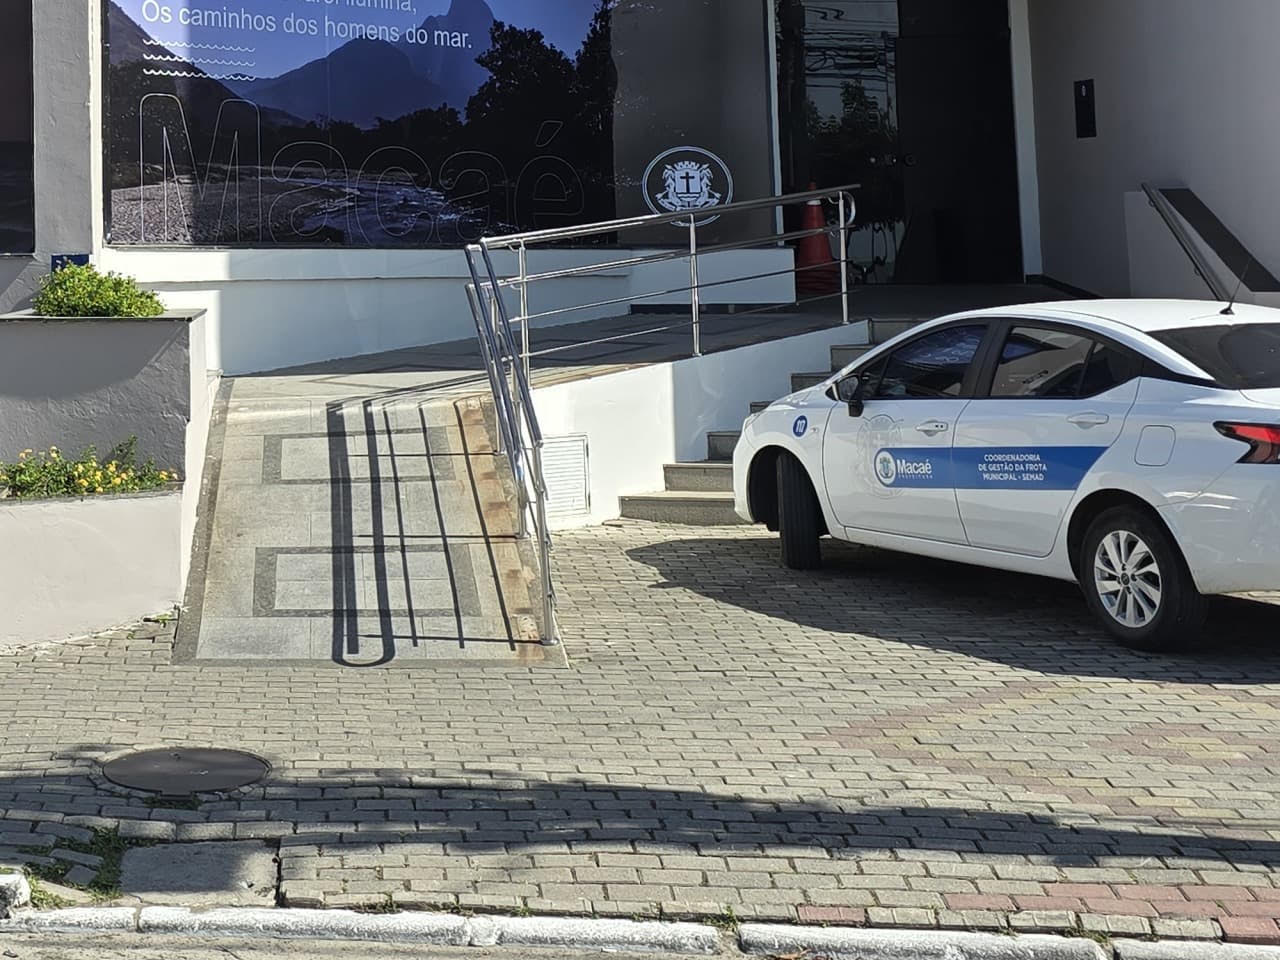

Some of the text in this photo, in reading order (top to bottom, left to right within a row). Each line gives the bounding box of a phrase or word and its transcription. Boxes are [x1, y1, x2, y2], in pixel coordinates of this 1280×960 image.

[142, 0, 471, 48] Os caminhos dos homens do mar.
[139, 93, 585, 243] Macaé
[896, 458, 932, 474] Macaé
[984, 454, 1040, 462] COORDENADORIA
[988, 462, 1014, 471] GESTÃO
